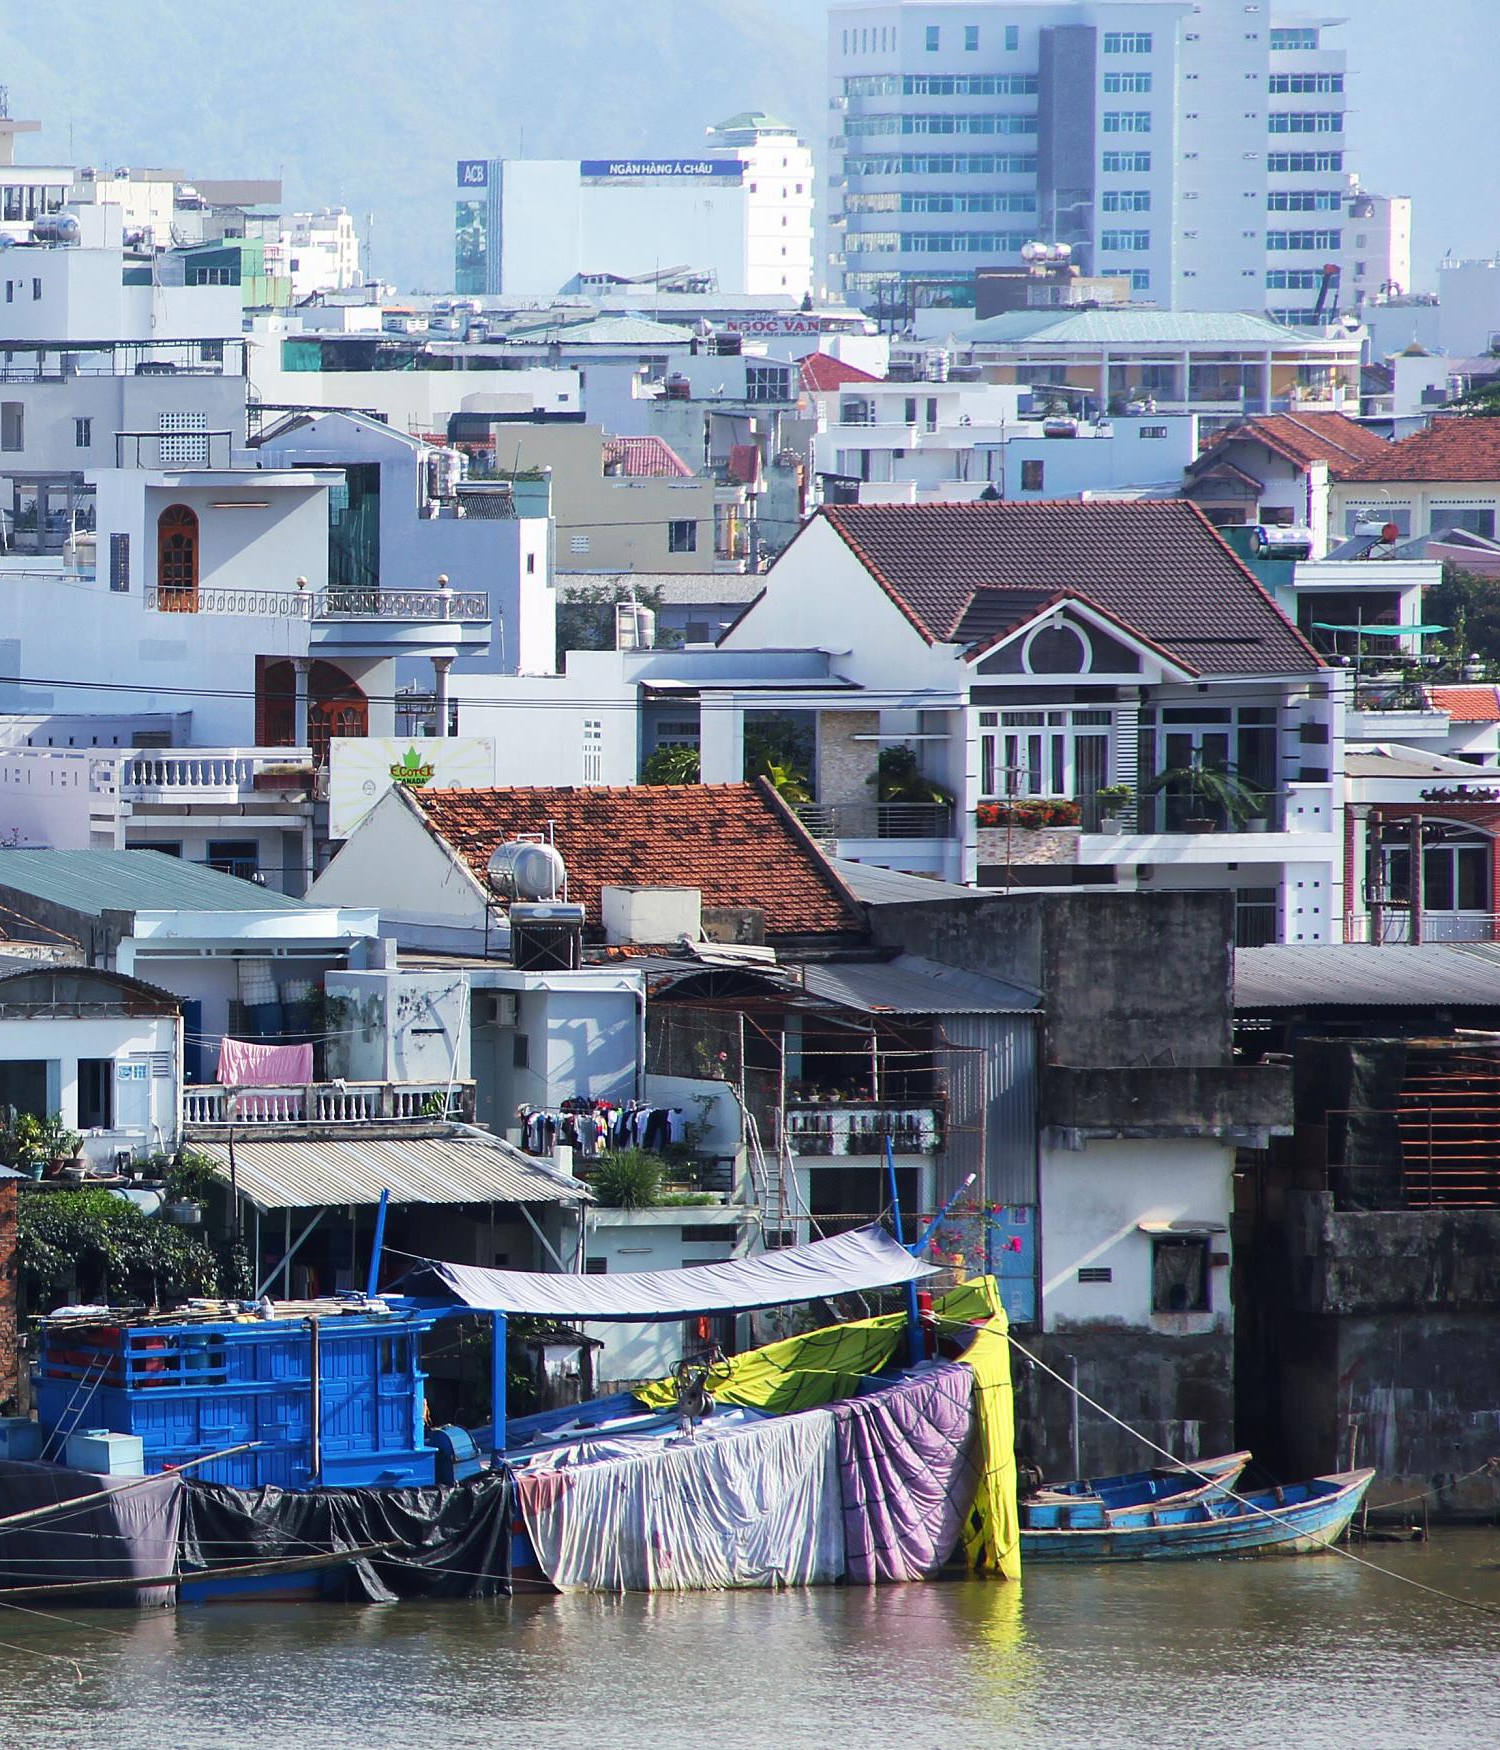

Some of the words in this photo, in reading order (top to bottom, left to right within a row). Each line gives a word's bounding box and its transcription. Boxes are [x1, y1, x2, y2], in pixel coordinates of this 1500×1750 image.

[464, 164, 484, 182] ACB
[609, 162, 640, 174] NGÂN
[642, 162, 672, 174] HÀNG
[683, 162, 713, 174] CHÂU
